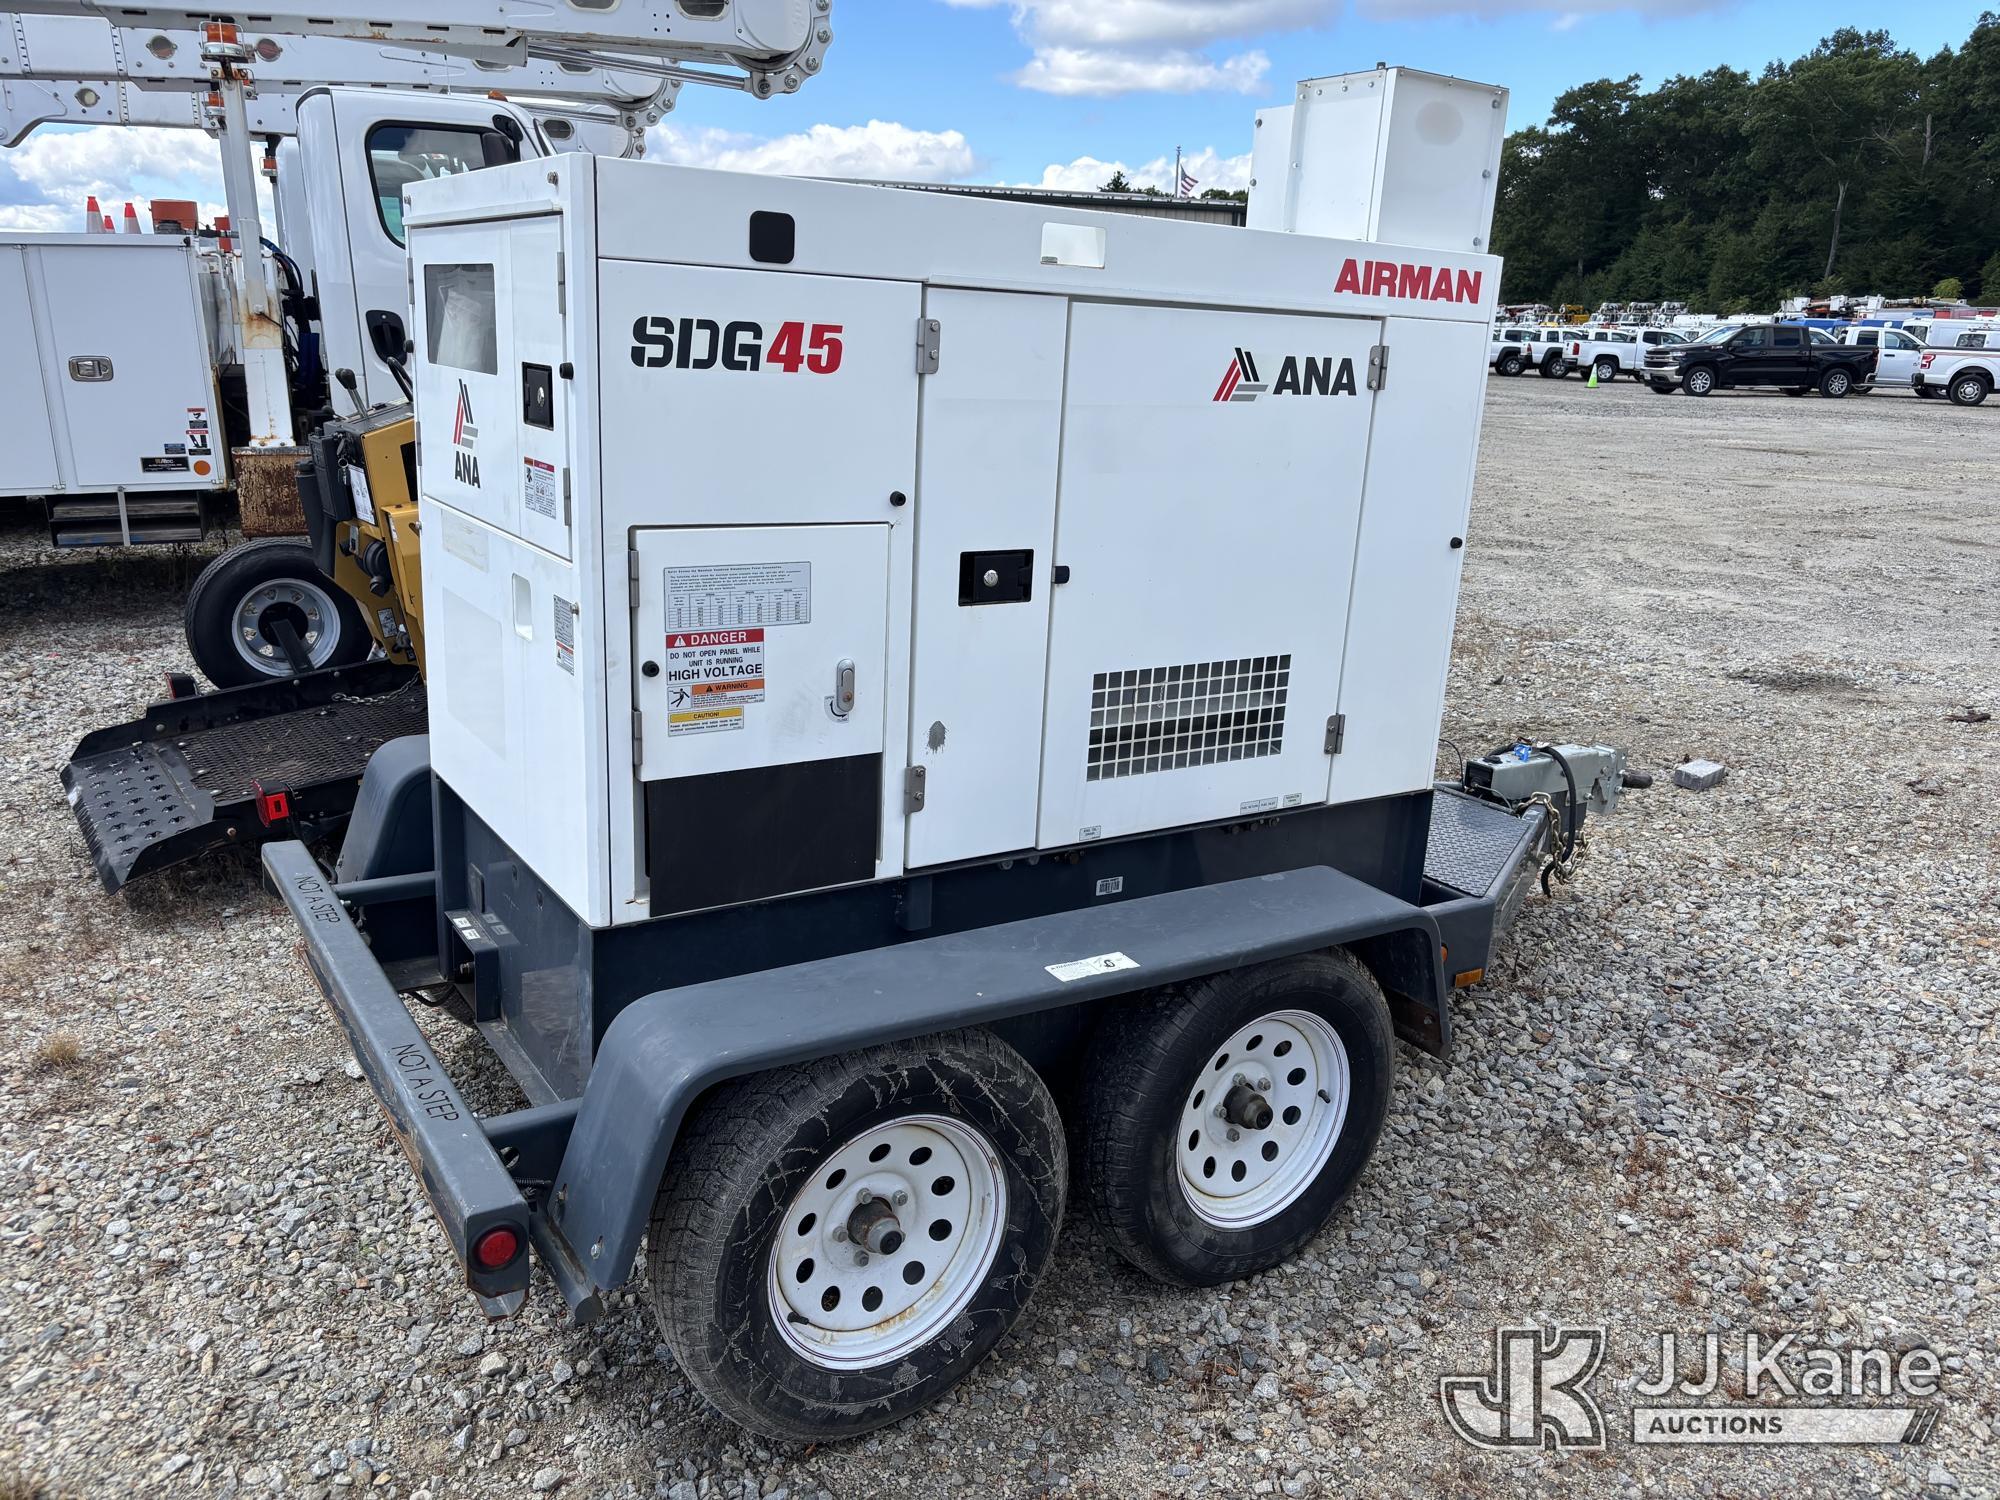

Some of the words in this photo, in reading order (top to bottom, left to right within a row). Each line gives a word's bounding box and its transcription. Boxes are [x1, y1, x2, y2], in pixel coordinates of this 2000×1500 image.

[1333, 258, 1483, 305] AIRMAN
[630, 316, 844, 375] SDG45
[1272, 355, 1357, 396] ANA
[454, 450, 481, 489] ANA
[690, 631, 747, 646] DANGER
[669, 652, 680, 660] DO
[682, 650, 696, 658] NOT
[699, 649, 717, 657] OPEN
[719, 648, 739, 656] PANEL
[742, 646, 761, 654] WHILE
[688, 659, 703, 667] UNIT
[715, 656, 744, 665] RUNNING
[668, 669, 700, 681] HIGH
[703, 663, 763, 679] VOLTAGE
[714, 682, 748, 691] WARNING
[294, 875, 324, 894] NOT
[304, 895, 326, 904] A
[310, 903, 341, 923] STEP
[391, 1043, 431, 1073] NOT
[408, 1078, 434, 1090] A
[418, 1089, 460, 1121] STEP
